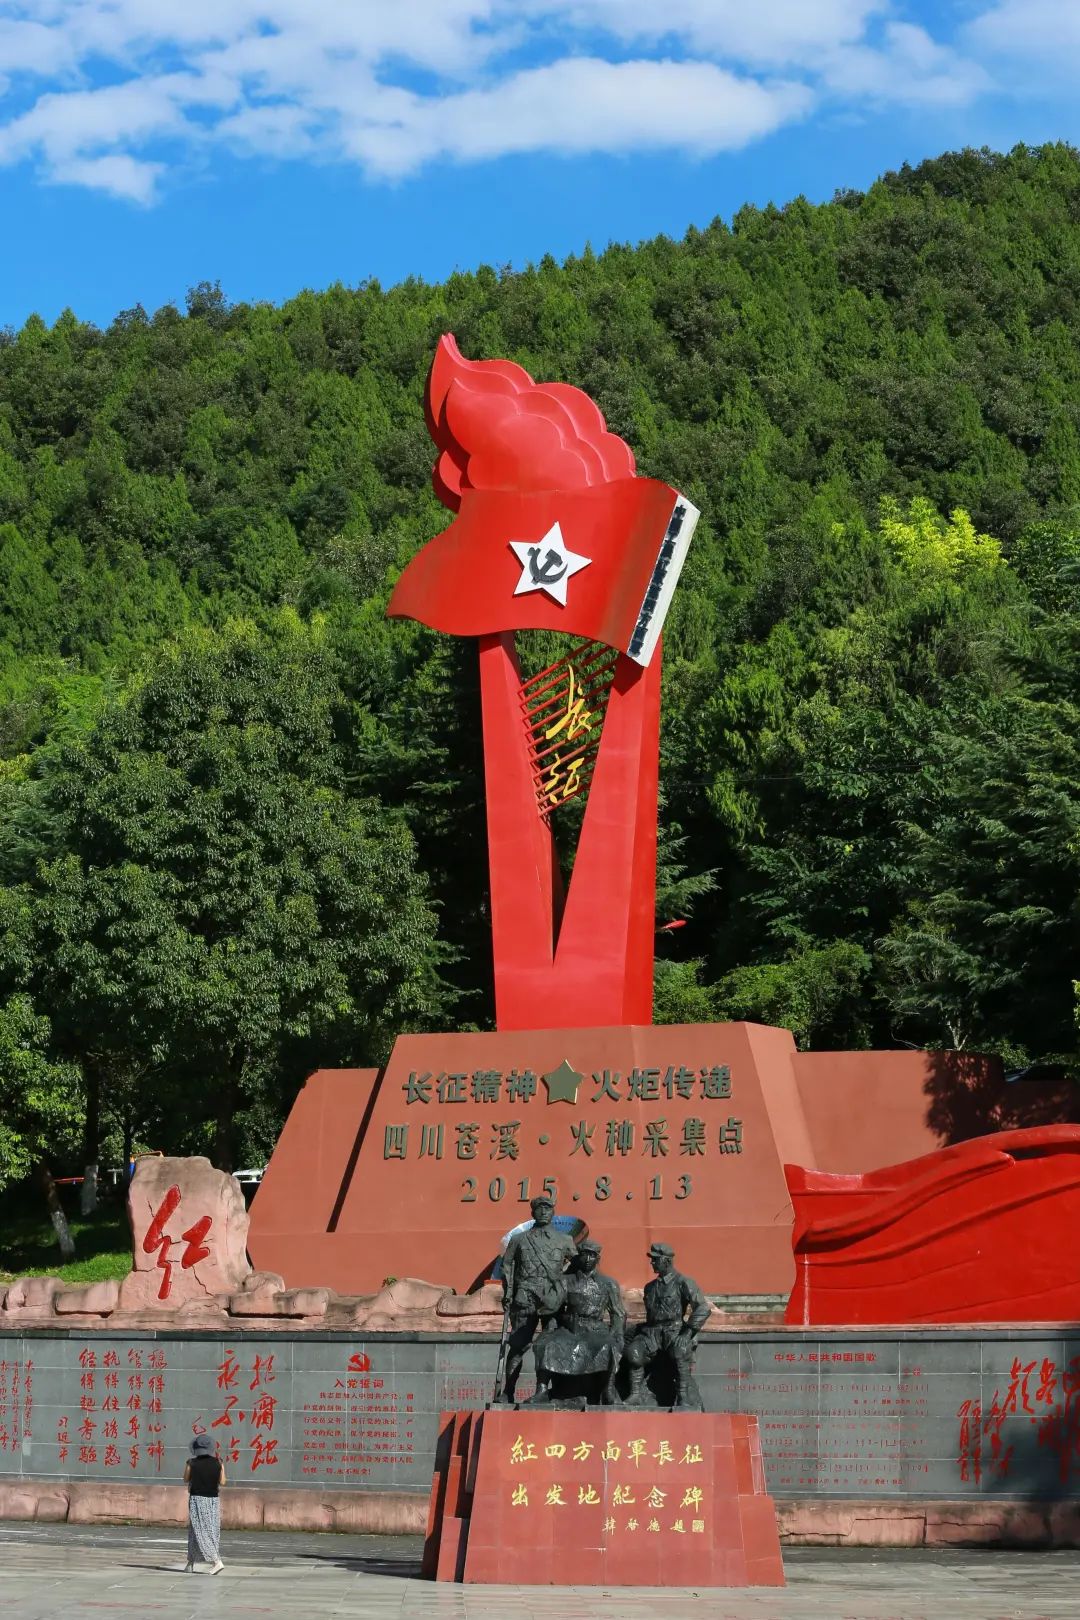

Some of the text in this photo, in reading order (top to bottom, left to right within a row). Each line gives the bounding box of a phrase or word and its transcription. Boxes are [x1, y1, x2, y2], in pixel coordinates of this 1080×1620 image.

[402, 1065, 732, 1104] 长征精神 火炬传递
[774, 1352, 877, 1363] 中华人民共和国国歌
[334, 1378, 384, 1388] 入党誓词
[510, 1435, 704, 1469] 紅四方面軍長征
[510, 1483, 704, 1513] 出发地紀念碑
